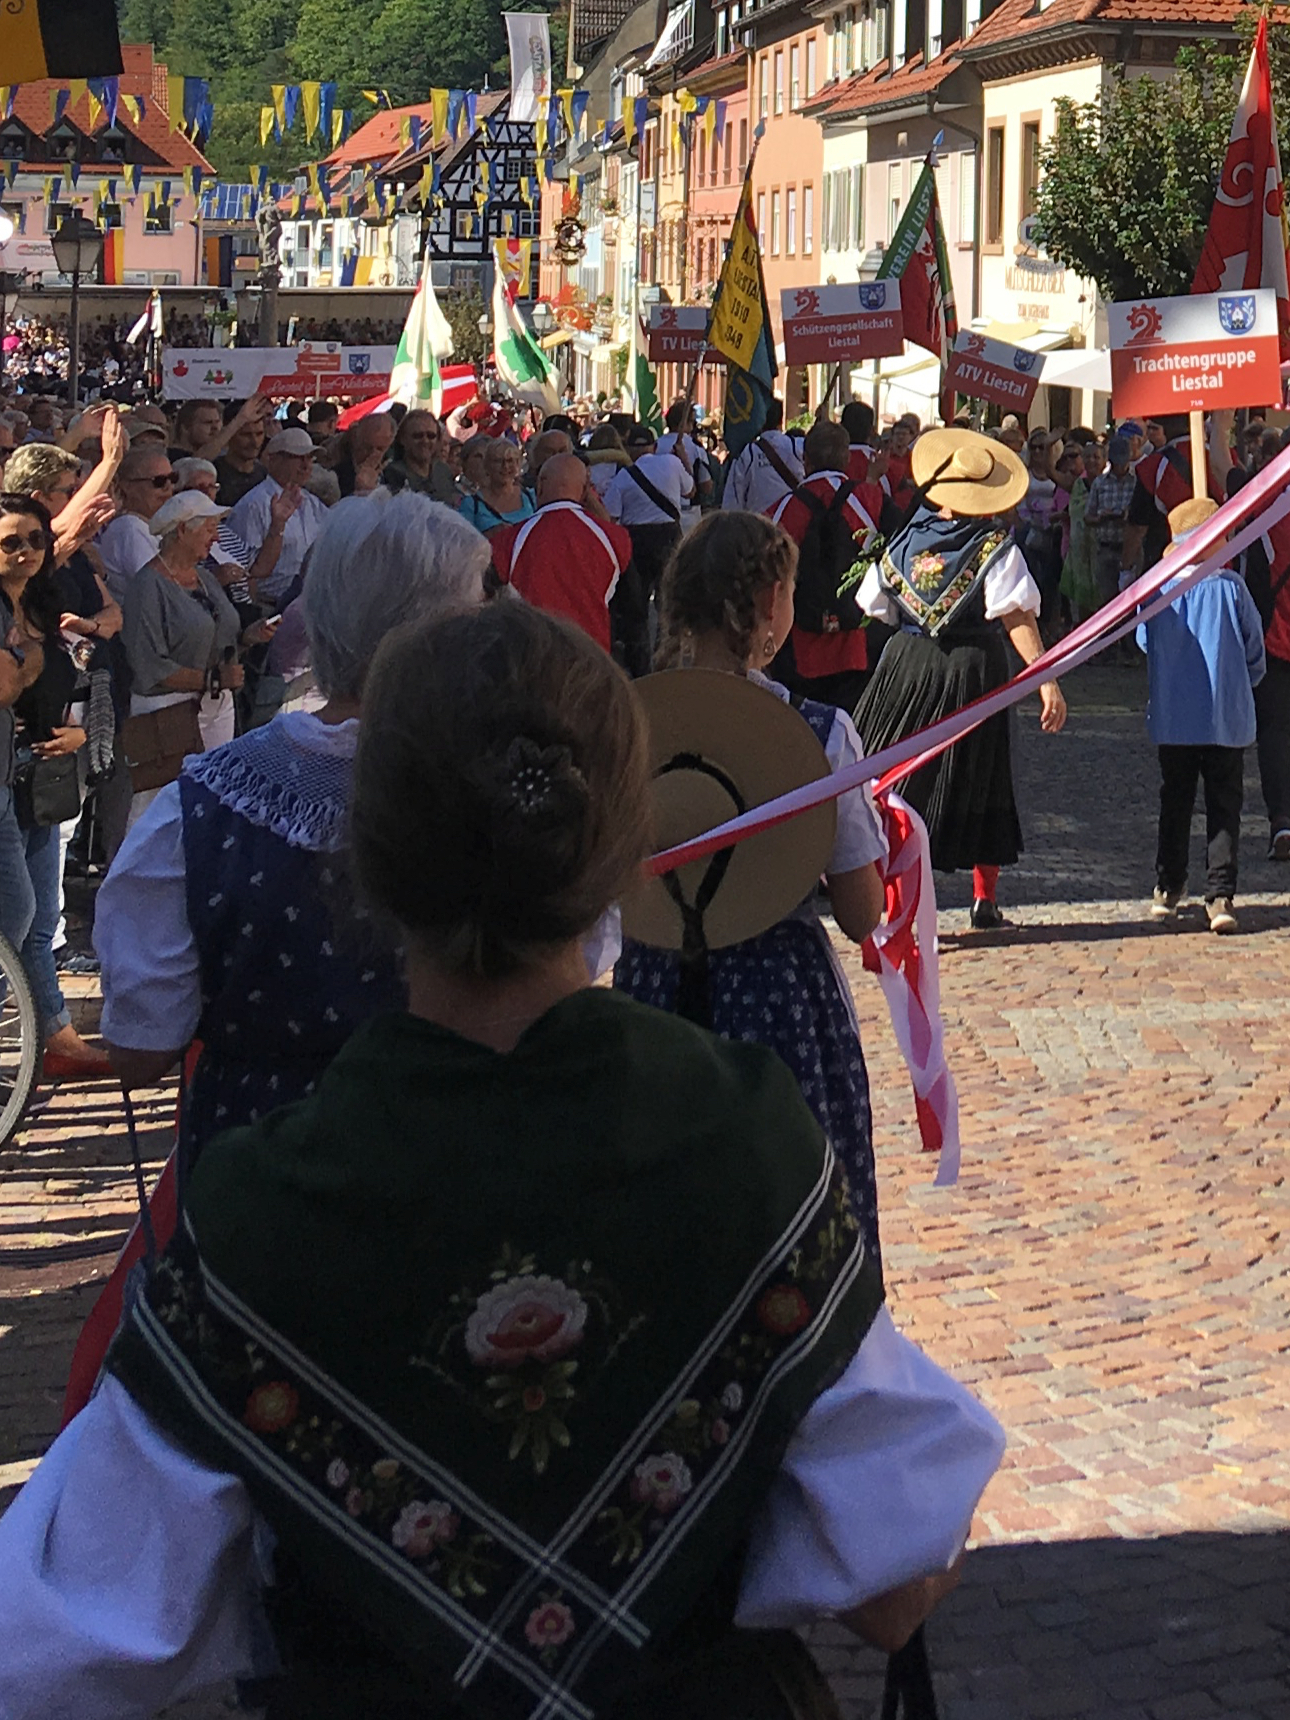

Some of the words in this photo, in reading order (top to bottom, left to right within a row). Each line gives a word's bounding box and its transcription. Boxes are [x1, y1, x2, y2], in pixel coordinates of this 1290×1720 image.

[792, 317, 893, 337] Schützengesellschaft
[661, 336, 678, 351] TV
[828, 335, 860, 348] Liestal
[1133, 350, 1256, 373] Trachtengruppe
[955, 363, 982, 381] ATV
[983, 371, 1028, 397] Liestal
[1172, 372, 1223, 392] Liestal
